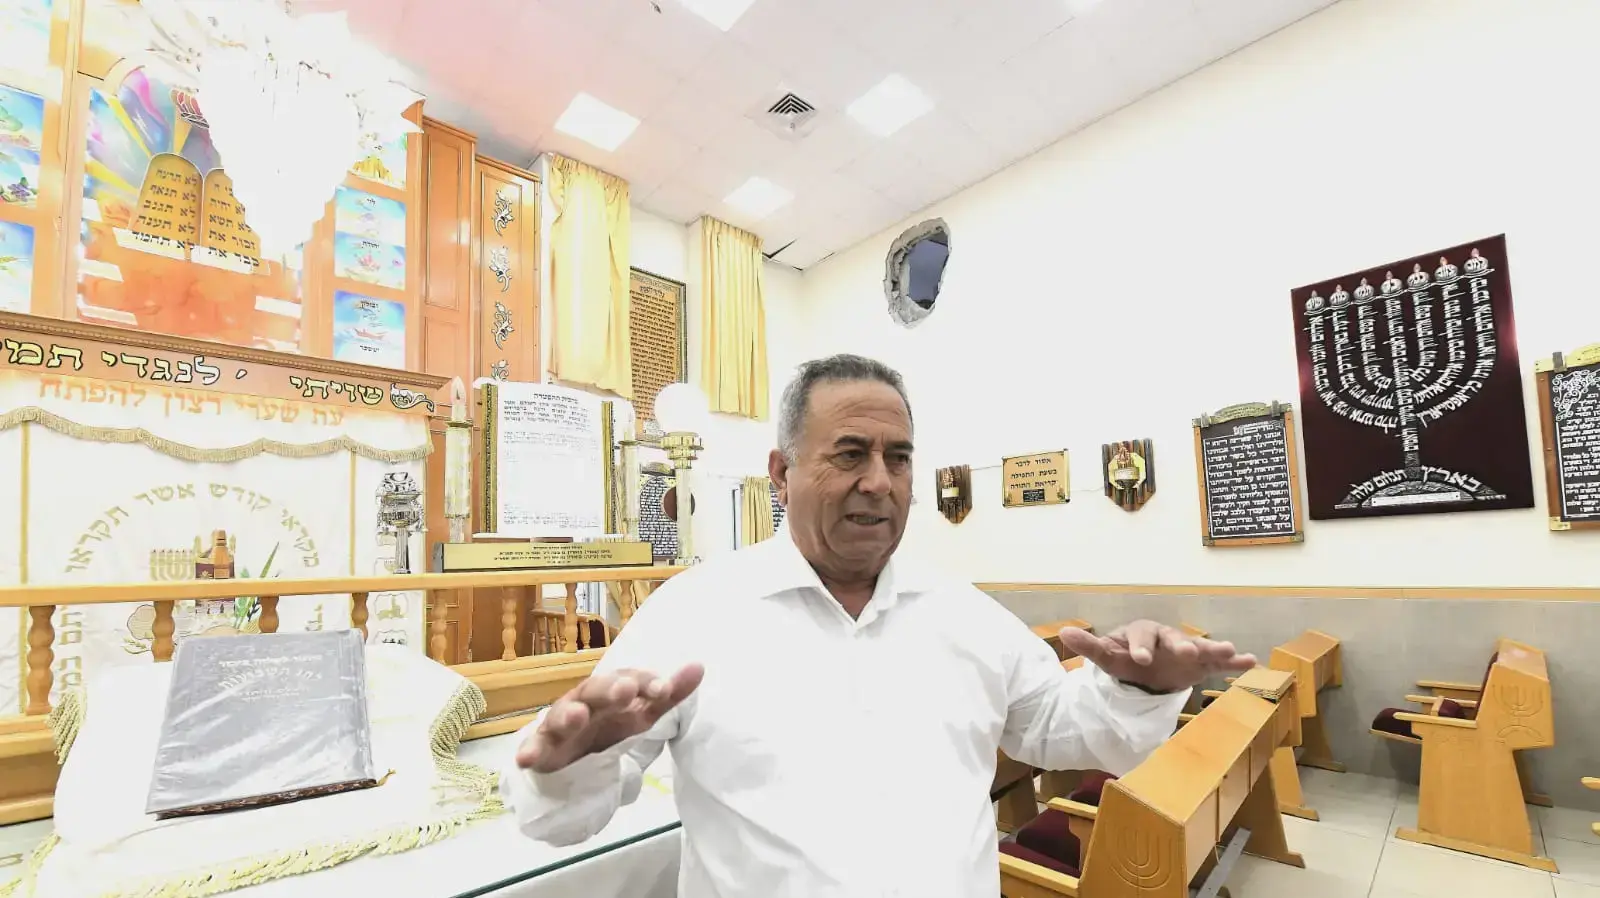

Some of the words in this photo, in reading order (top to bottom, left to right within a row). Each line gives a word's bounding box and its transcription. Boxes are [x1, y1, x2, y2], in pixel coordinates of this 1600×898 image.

[208, 229, 226, 243] את
[208, 246, 227, 259] את
[0, 338, 83, 370] תמ
[101, 351, 220, 385] לנגדי
[39, 376, 147, 408] להפתח
[289, 375, 384, 405] שויתי
[1455, 380, 1483, 393] כל
[312, 407, 344, 426] עת
[1374, 414, 1398, 433] סלה
[1253, 432, 1261, 441] לך
[1247, 449, 1256, 457] כל
[1421, 465, 1483, 492] בארץ
[134, 483, 196, 506] אשר
[208, 482, 272, 512] קודש
[1349, 480, 1374, 499] סלה
[1212, 517, 1222, 525] לך
[1278, 512, 1290, 520] על
[64, 505, 130, 573] תקראו
